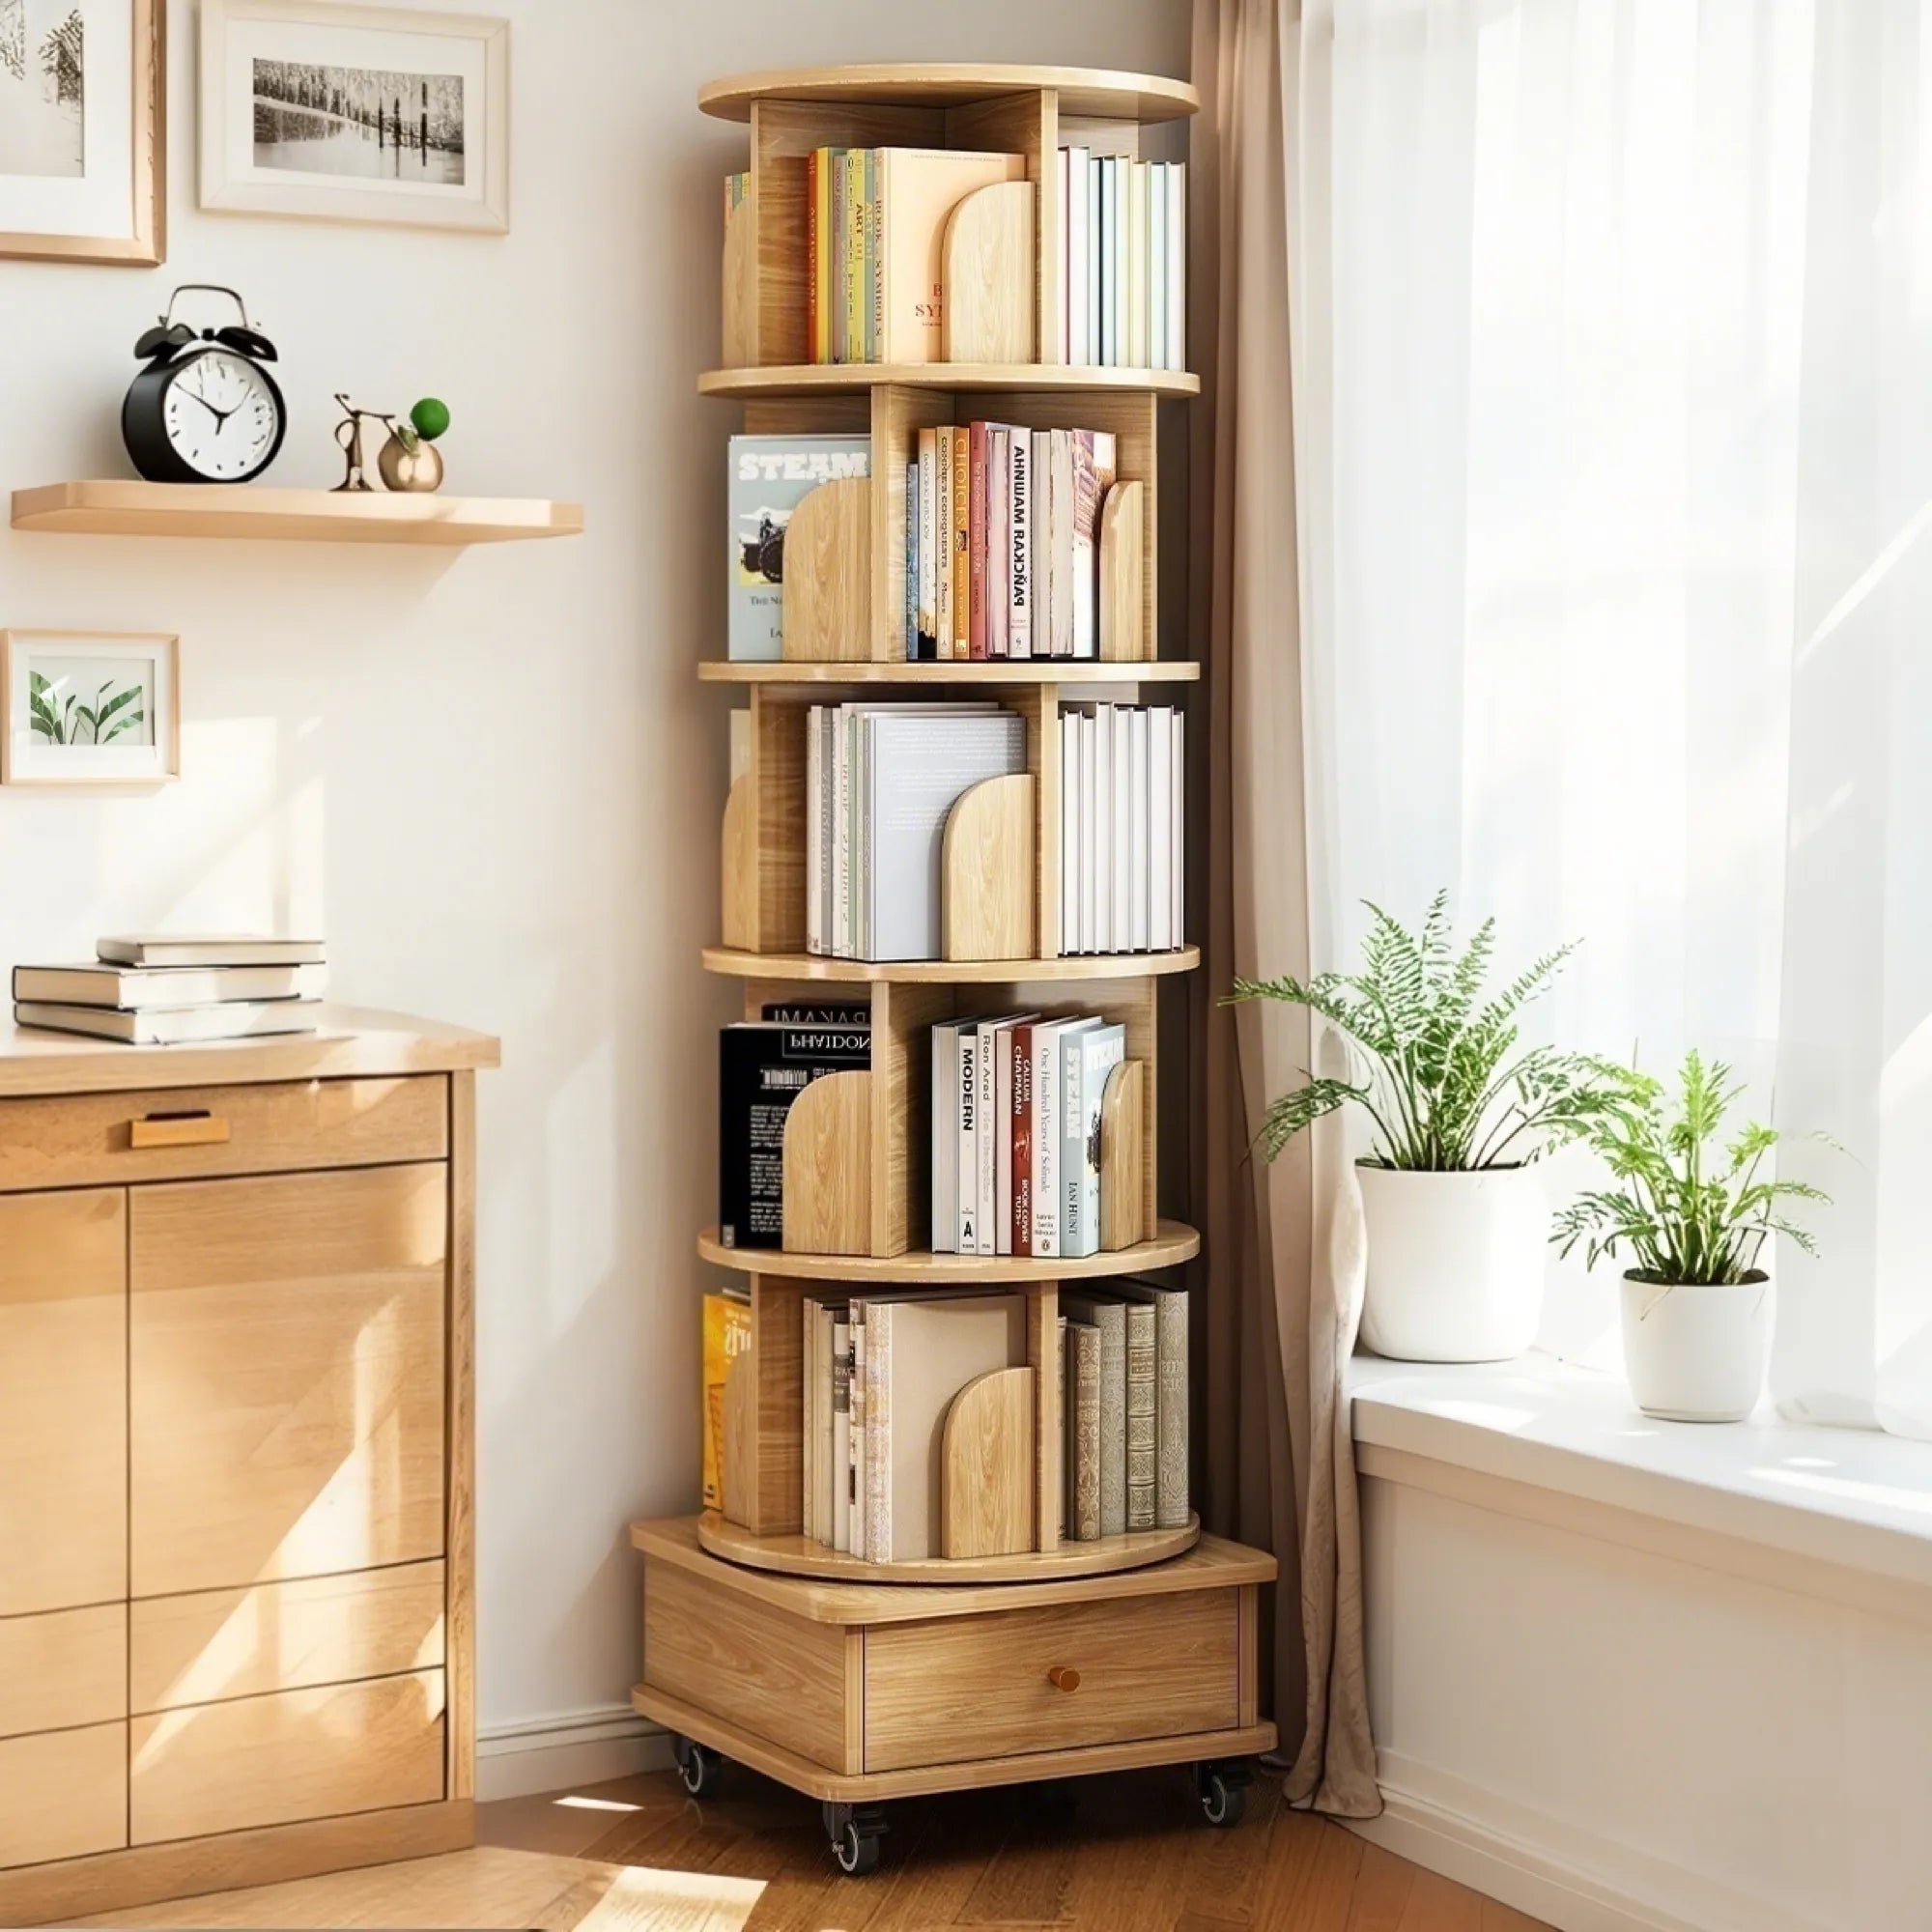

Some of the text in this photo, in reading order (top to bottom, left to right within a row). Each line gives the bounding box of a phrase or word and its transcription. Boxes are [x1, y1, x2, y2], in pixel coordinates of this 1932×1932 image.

[739, 452, 867, 483] STEAM
[1041, 1047, 1050, 1067] One
[963, 1049, 974, 1131] MODERN
[1041, 1070, 1050, 1113] Hundred
[1066, 1046, 1081, 1139] STEAM
[1041, 1115, 1050, 1140] Years
[1041, 1142, 1051, 1153] of
[1068, 1182, 1078, 1236] IAN HUNT
